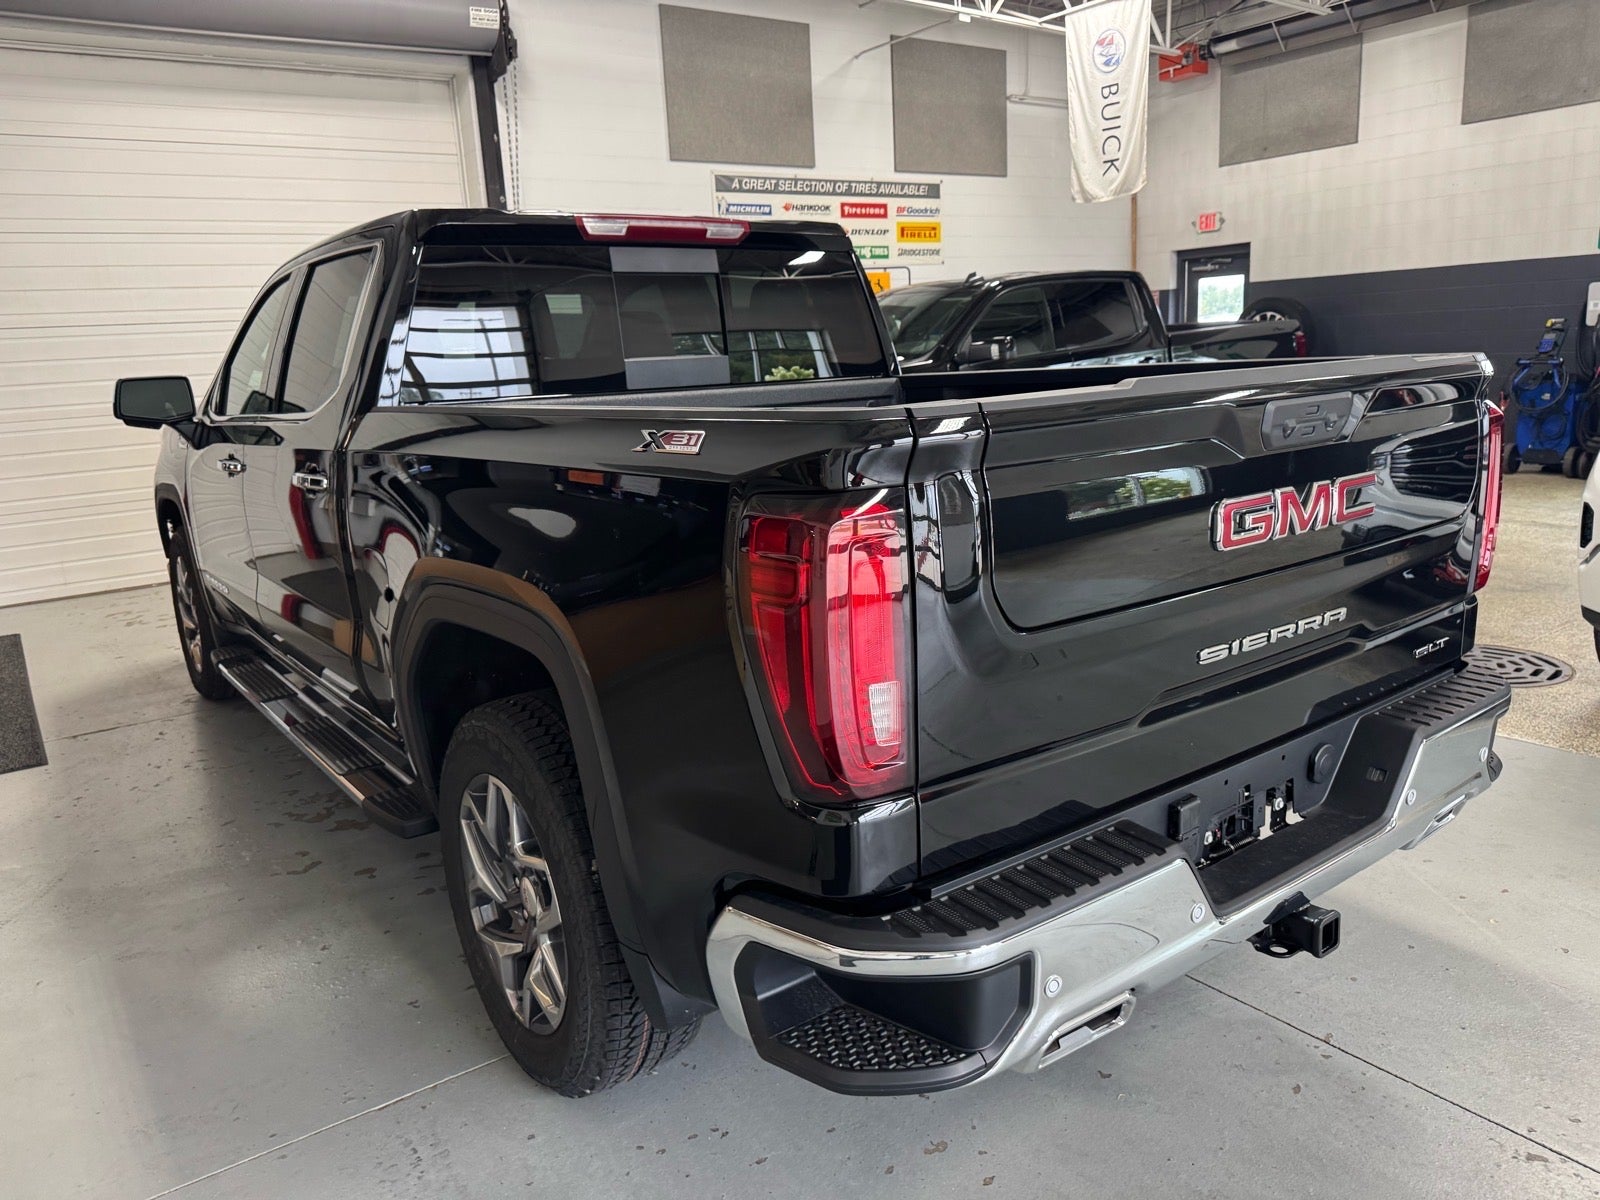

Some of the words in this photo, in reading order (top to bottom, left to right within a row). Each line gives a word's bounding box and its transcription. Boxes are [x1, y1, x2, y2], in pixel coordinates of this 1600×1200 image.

[1101, 82, 1121, 177] BUICK
[731, 178, 740, 190] A
[742, 179, 776, 192] GREAT
[778, 181, 833, 193] SELECTION
[835, 182, 849, 193] OF
[850, 183, 877, 194] TIRES
[878, 183, 929, 196] AVAILABLE!
[727, 204, 771, 215] MICHELIN
[843, 205, 885, 216] Firestone
[896, 206, 941, 215] BFGoodrich
[1199, 213, 1217, 231] EXIT
[851, 228, 889, 236] DUNLOP
[900, 226, 937, 239] PIRELLI
[897, 247, 941, 257] BRIDGESTONE
[632, 429, 705, 454] X31
[1208, 471, 1377, 551] GMC
[1197, 606, 1348, 665] SIERRA
[1413, 636, 1451, 659] SLT
